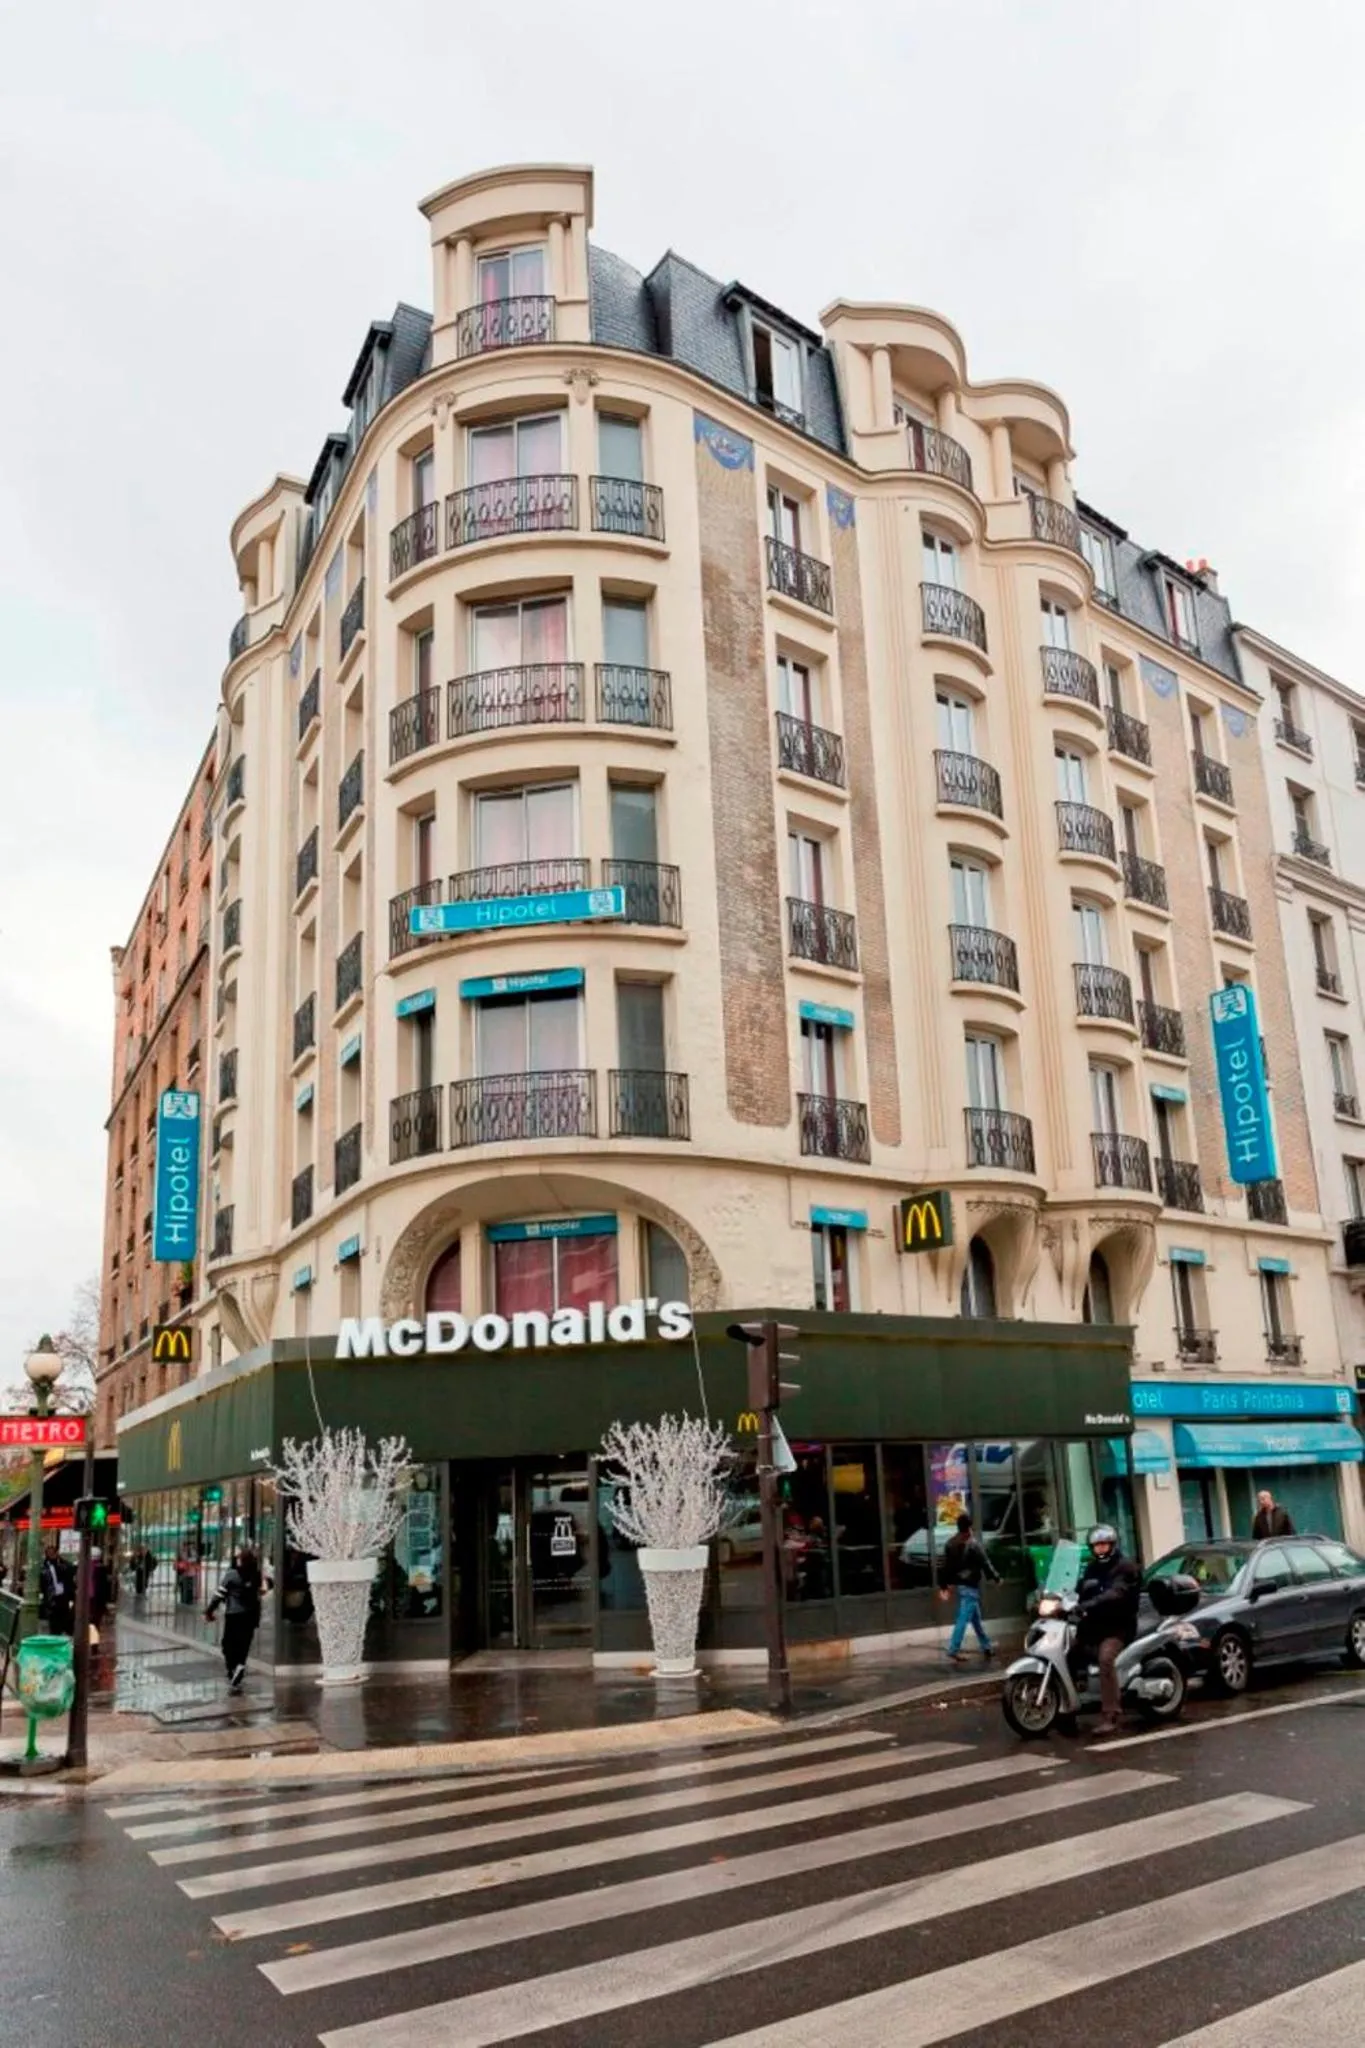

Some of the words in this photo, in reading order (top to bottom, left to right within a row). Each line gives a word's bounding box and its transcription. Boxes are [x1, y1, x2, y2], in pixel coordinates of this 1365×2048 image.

[476, 900, 556, 922] Hipotel
[1223, 1037, 1262, 1163] Hipotel
[164, 1137, 194, 1244] Hipotel
[335, 1297, 692, 1358] McDonald's
[1202, 1390, 1238, 1409] Paris
[1243, 1390, 1304, 1410] Printania
[2, 1421, 80, 1440] METRO
